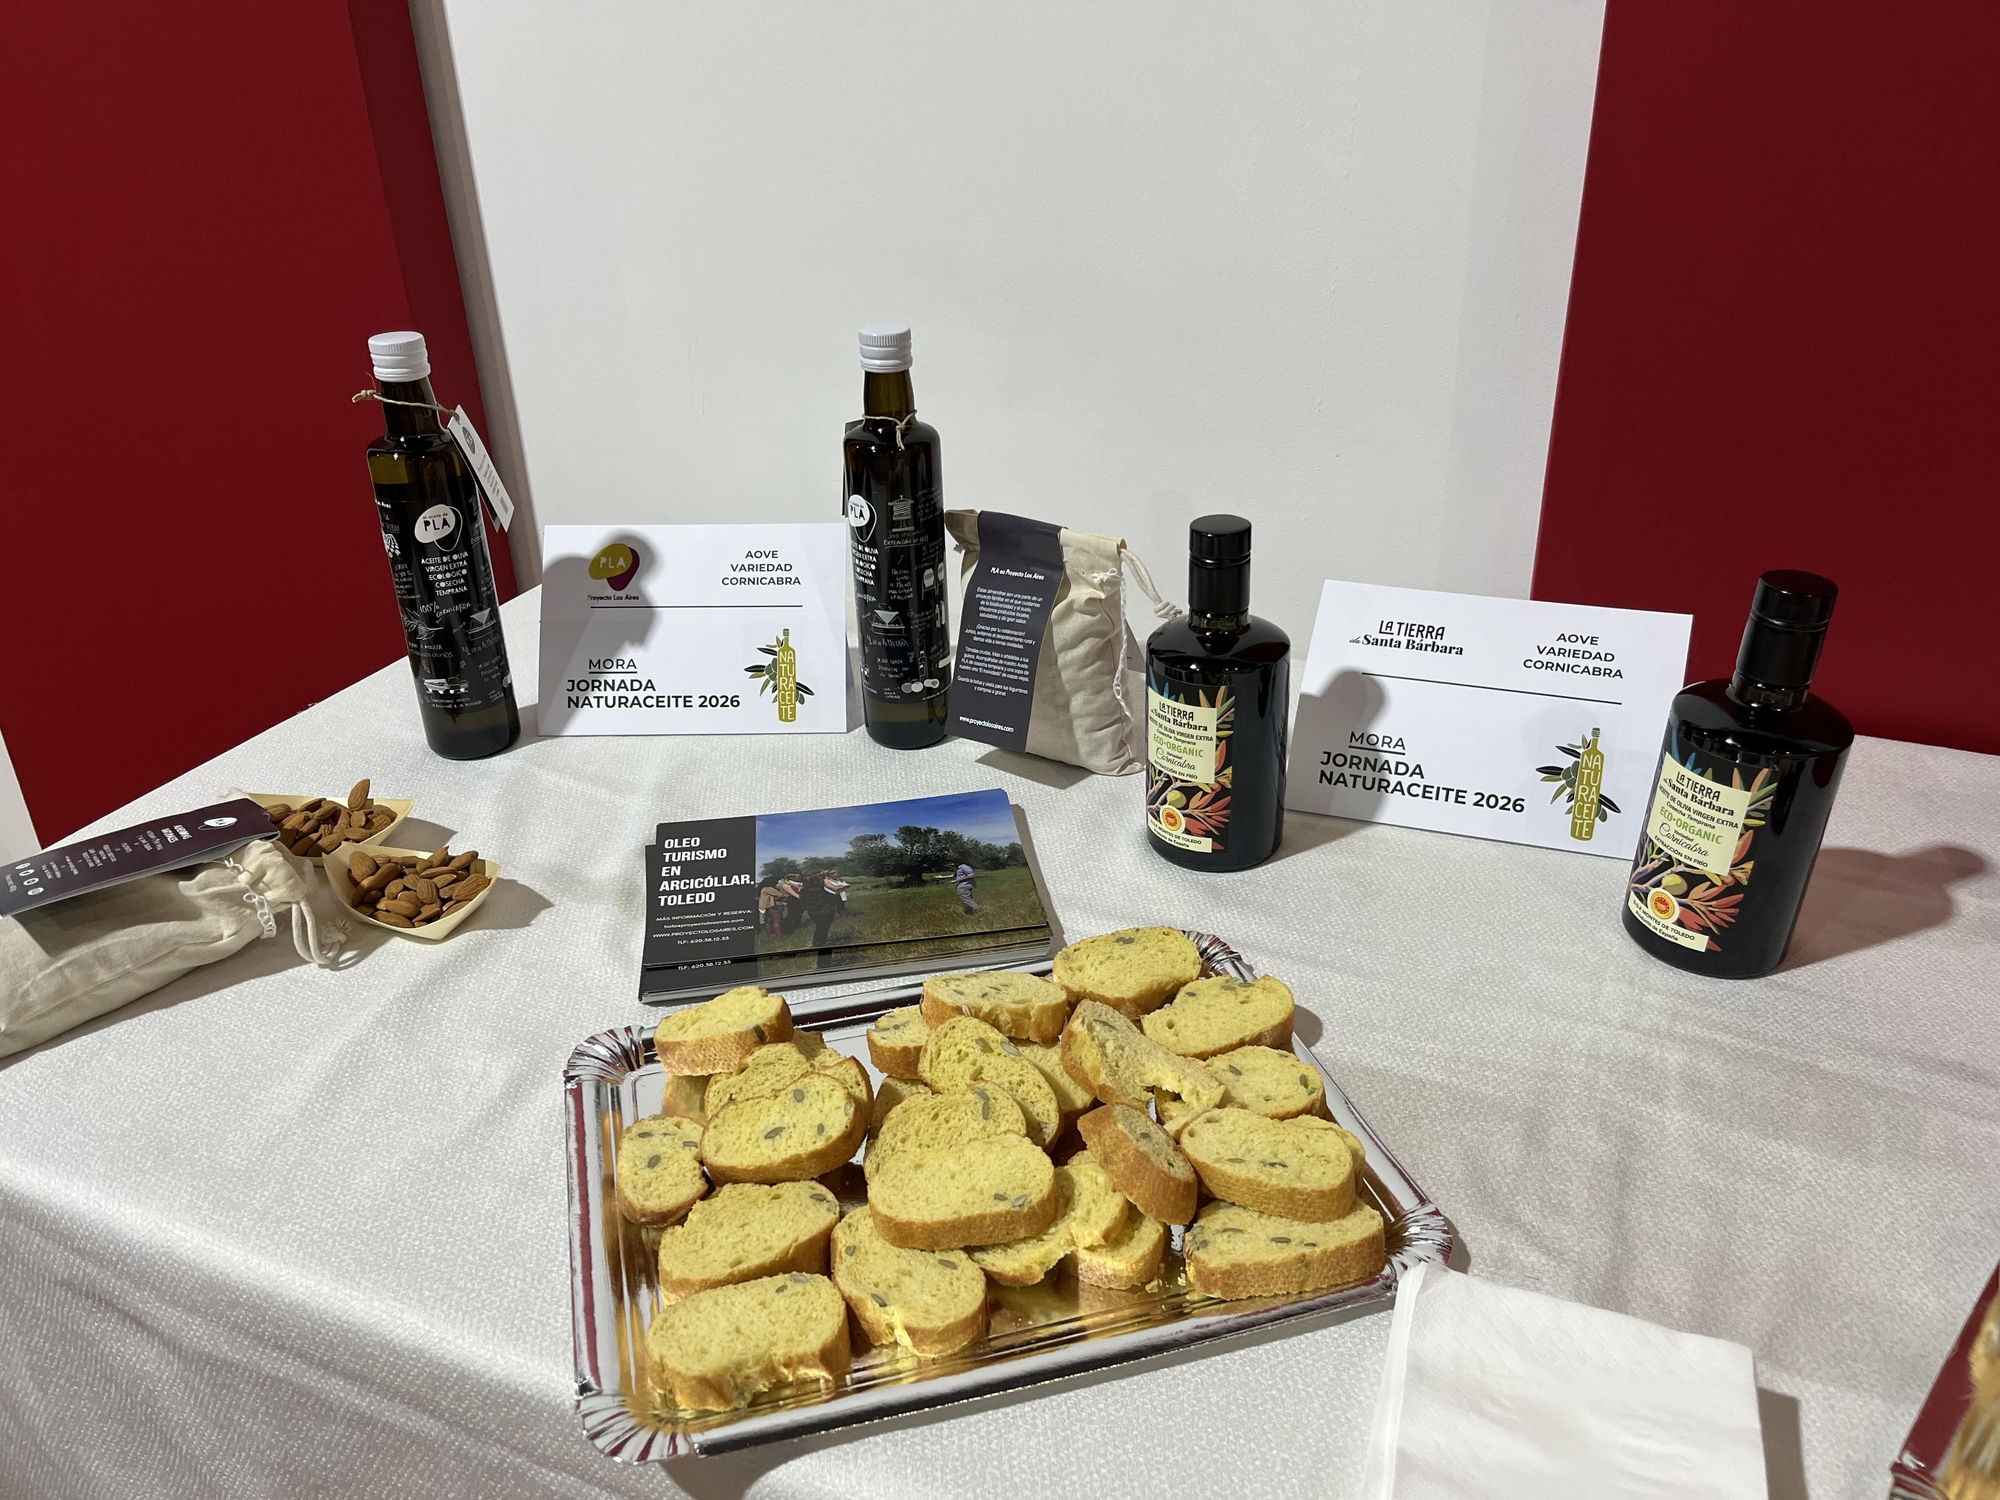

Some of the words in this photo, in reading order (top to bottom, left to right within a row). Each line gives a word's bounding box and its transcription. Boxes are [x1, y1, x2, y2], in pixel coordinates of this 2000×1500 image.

[424, 518, 451, 532] PLA
[421, 557, 442, 565] ACEITE
[452, 551, 469, 561] OLIVA
[745, 550, 779, 559] AOVE
[425, 564, 449, 573] VIRGEN
[449, 560, 468, 570] EXTRA
[600, 557, 626, 569] PLA
[731, 563, 793, 573] VARIEDAD
[435, 578, 465, 588] COSECHA
[721, 576, 802, 586] CORNICABRA
[435, 586, 468, 597] TEMPRANA
[1379, 620, 1394, 635] LA
[1397, 622, 1445, 641] TIERRA
[1362, 634, 1401, 649] Santa
[1405, 639, 1464, 656] Bárbara
[1556, 633, 1599, 646] AOVE
[1537, 645, 1615, 662] VARIEDAD
[589, 659, 637, 670] MORA
[1523, 659, 1624, 679] CORNICABRA
[567, 679, 656, 692] JORNADA
[567, 696, 693, 709] NATURACEITE
[698, 695, 741, 708] 2026
[1159, 701, 1167, 714] LA
[1166, 704, 1194, 722] TIERRA
[1154, 709, 1171, 723] Santa
[1173, 718, 1208, 732] Bárbara
[1176, 731, 1195, 740] VIRGEN
[1349, 731, 1406, 751] MORA
[1156, 748, 1196, 771] Cornicabra
[1320, 751, 1425, 779] JORNADA
[1318, 770, 1468, 805] NATURACEITE
[1473, 792, 1525, 813] 2026
[1676, 771, 1686, 787] LA
[1685, 777, 1721, 802] TIERRA
[1668, 779, 1689, 799] Santa
[1691, 794, 1735, 816] Bárbara
[1666, 802, 1686, 817] Cosecha
[1687, 814, 1716, 830] Temprana
[1671, 796, 1676, 804] DE
[1677, 800, 1692, 813] OLIVA
[1693, 808, 1716, 822] VIRGEN
[1716, 818, 1739, 829] EXTRA
[664, 837, 700, 849] OLEO
[1182, 837, 1202, 845] TOLEDO
[1659, 822, 1709, 857] Cornicabra
[663, 848, 727, 863] TURISMO
[1655, 835, 1684, 858] EXTRACCIÓN
[1694, 859, 1709, 868] FRÍO
[662, 866, 681, 877] EN
[659, 874, 755, 892] ARCICÓLLAR,
[658, 892, 716, 907] TOLEDO
[653, 926, 755, 938] WWW.PROYECTOLOSAIRES.COM
[1642, 910, 1661, 926] MONTES
[1671, 928, 1695, 941] TOLEDO
